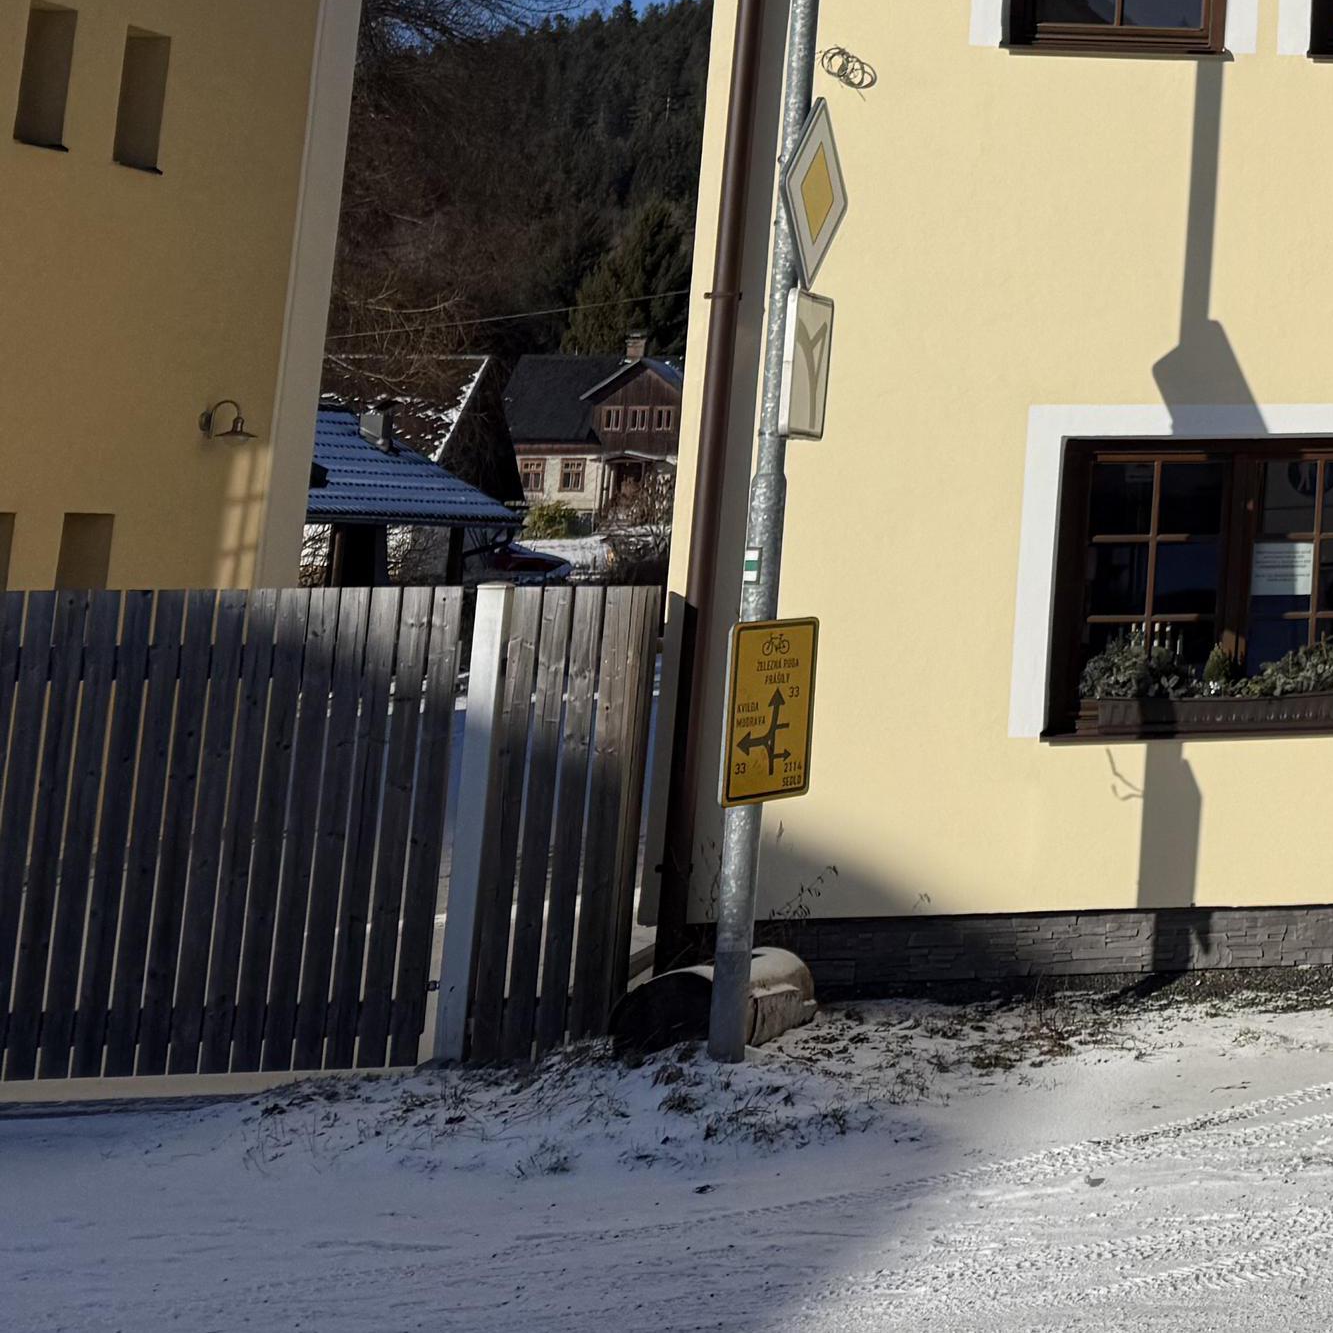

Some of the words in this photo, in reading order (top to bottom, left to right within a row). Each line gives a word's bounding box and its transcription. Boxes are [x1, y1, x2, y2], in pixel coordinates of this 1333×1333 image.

[788, 686, 800, 698] 33
[735, 762, 746, 775] 33
[784, 762, 801, 773] 2114
